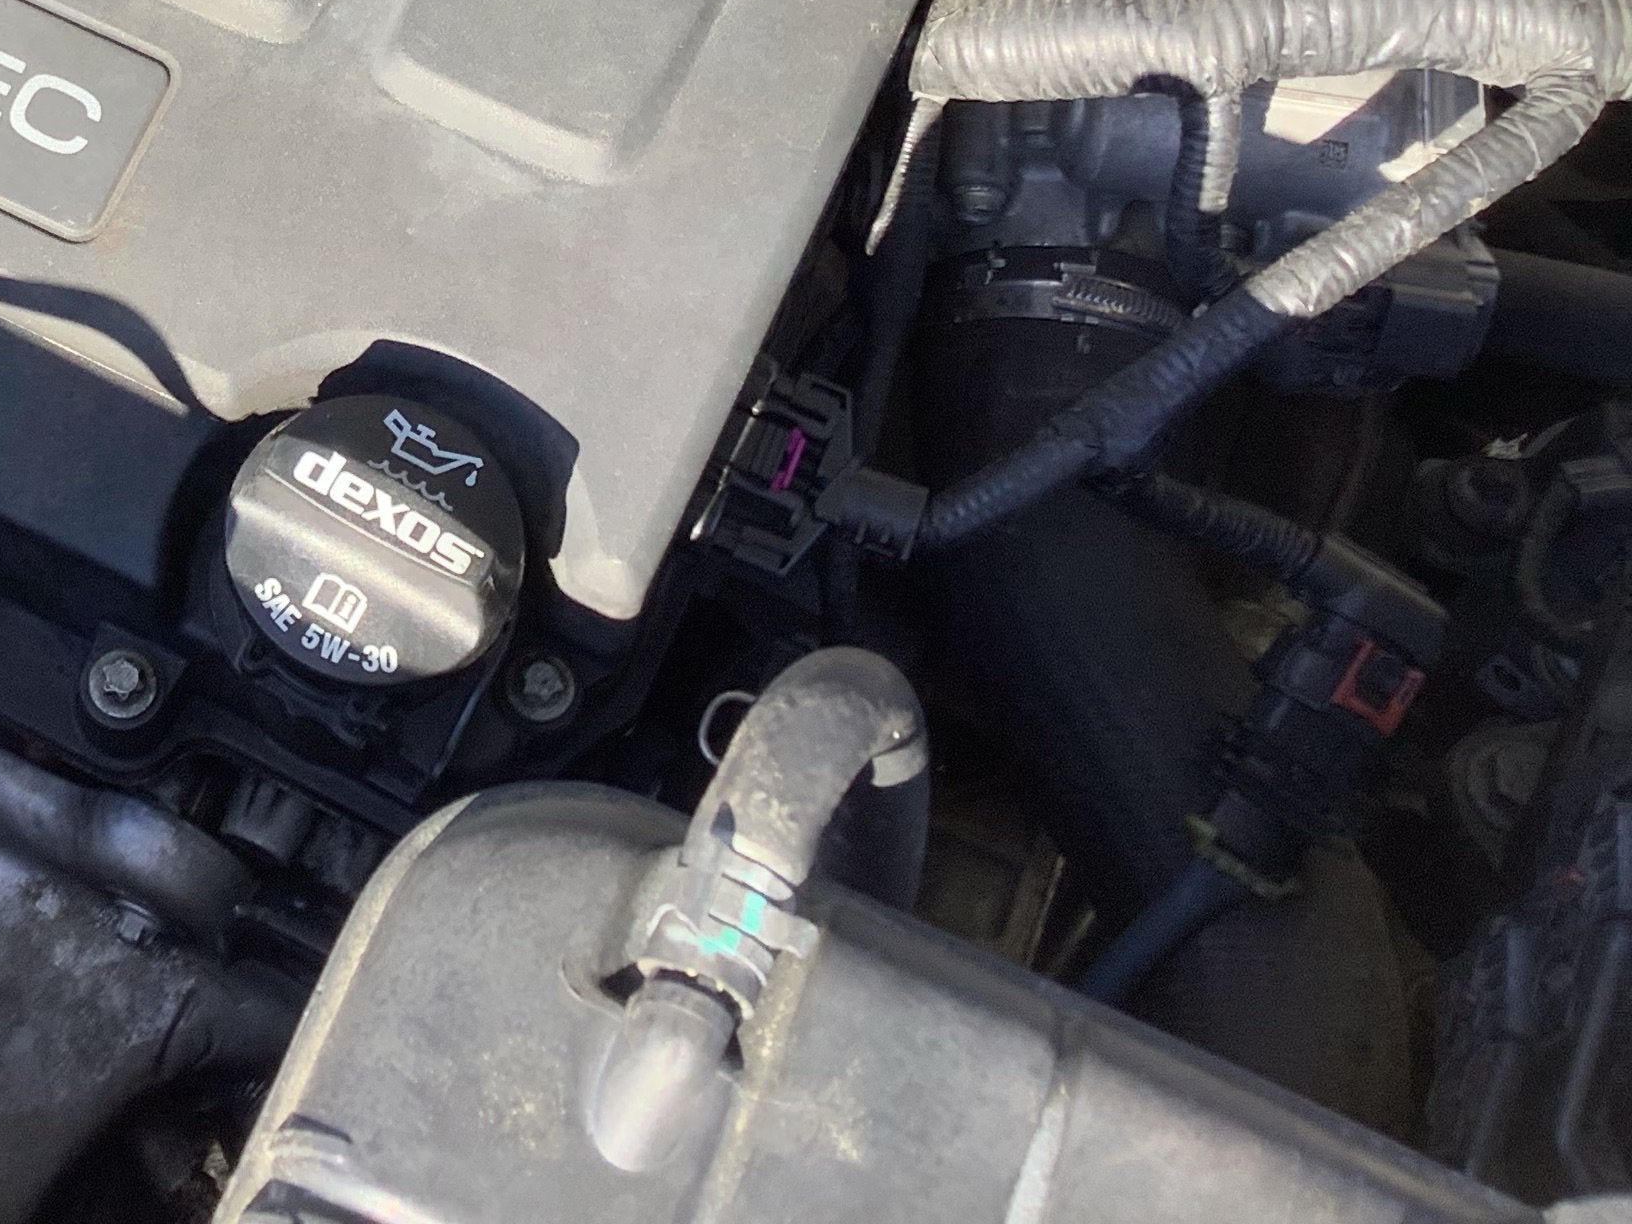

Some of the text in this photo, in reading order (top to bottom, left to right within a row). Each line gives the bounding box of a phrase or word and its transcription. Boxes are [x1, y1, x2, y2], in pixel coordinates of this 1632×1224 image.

[293, 451, 477, 575] dexos
[254, 577, 399, 674] SAE 5W-30
